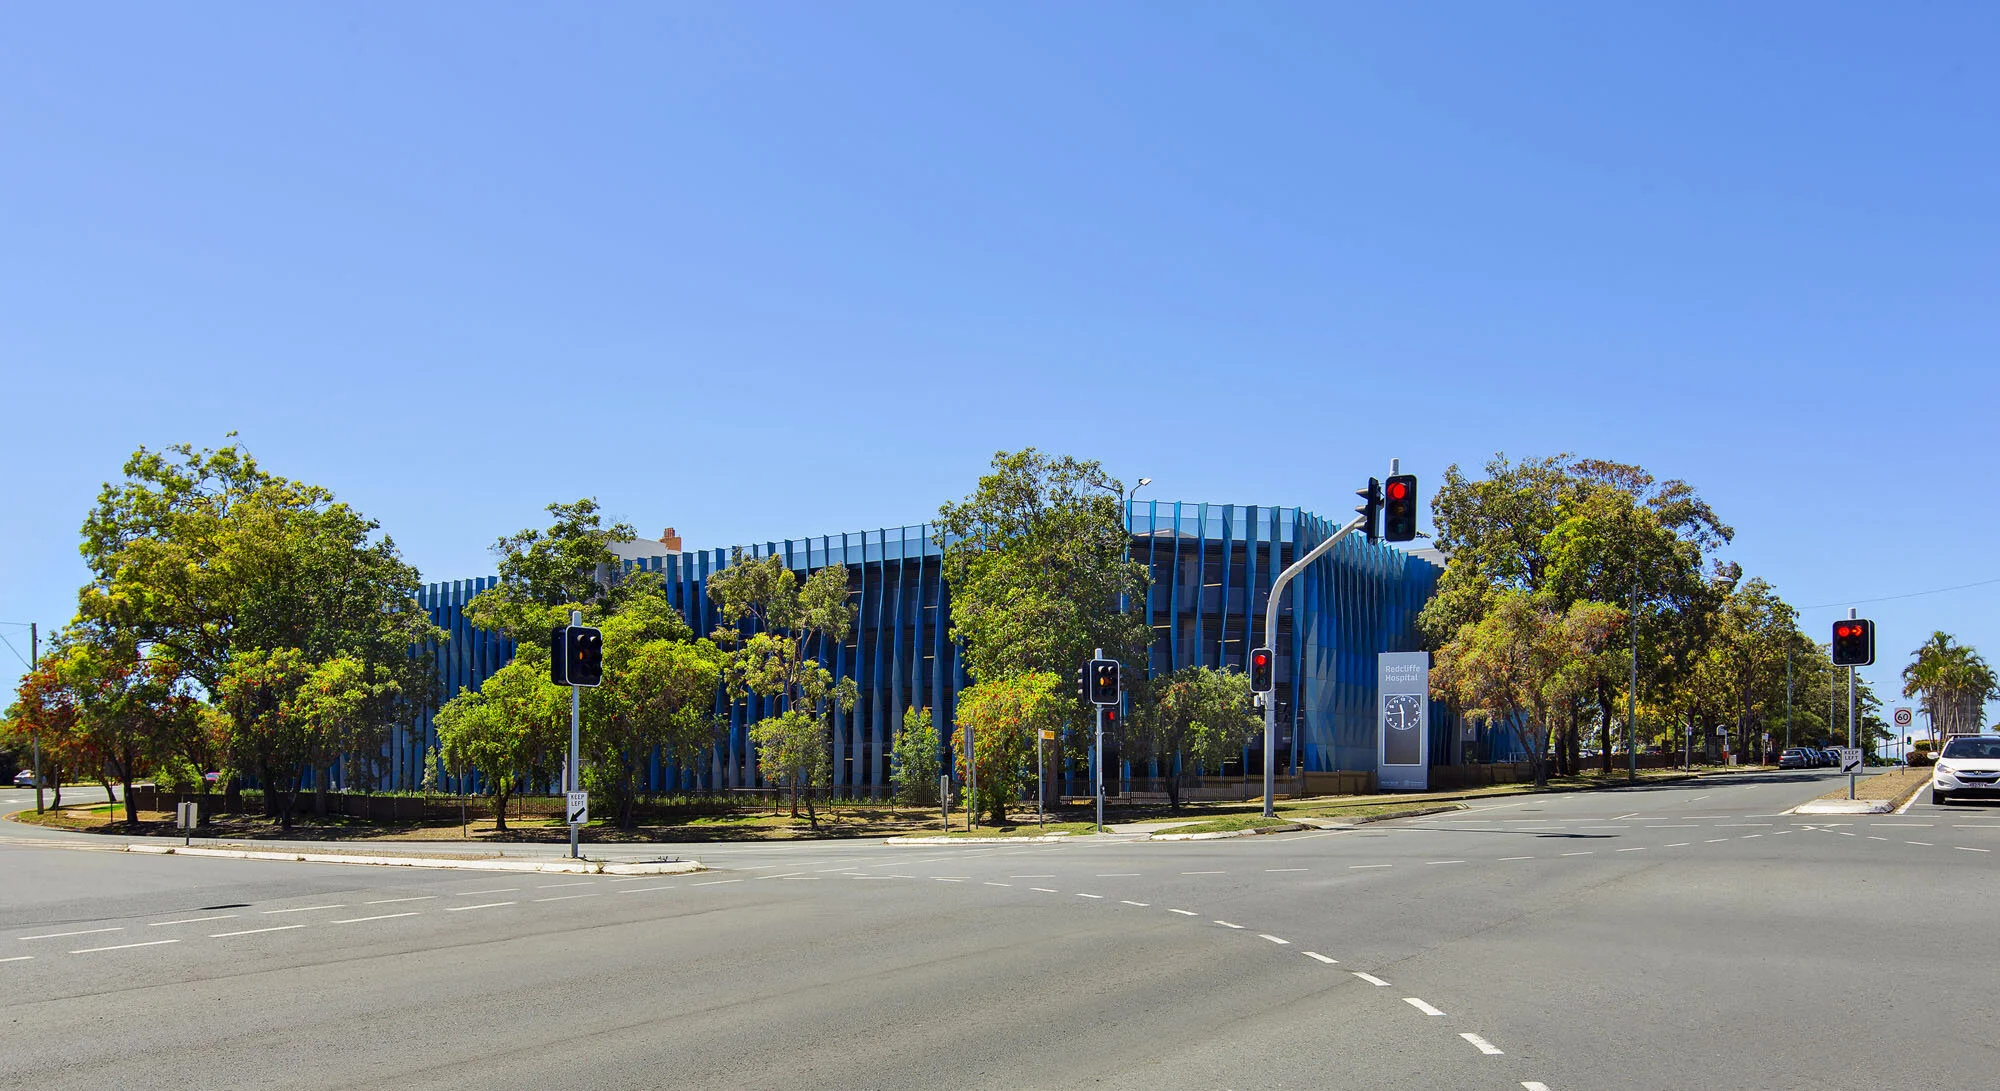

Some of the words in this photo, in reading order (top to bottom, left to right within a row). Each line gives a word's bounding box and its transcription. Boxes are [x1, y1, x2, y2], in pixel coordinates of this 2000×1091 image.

[1385, 664, 1420, 672] Redcliffe
[1385, 673, 1418, 682] Hospital
[1897, 713, 1908, 721] 60
